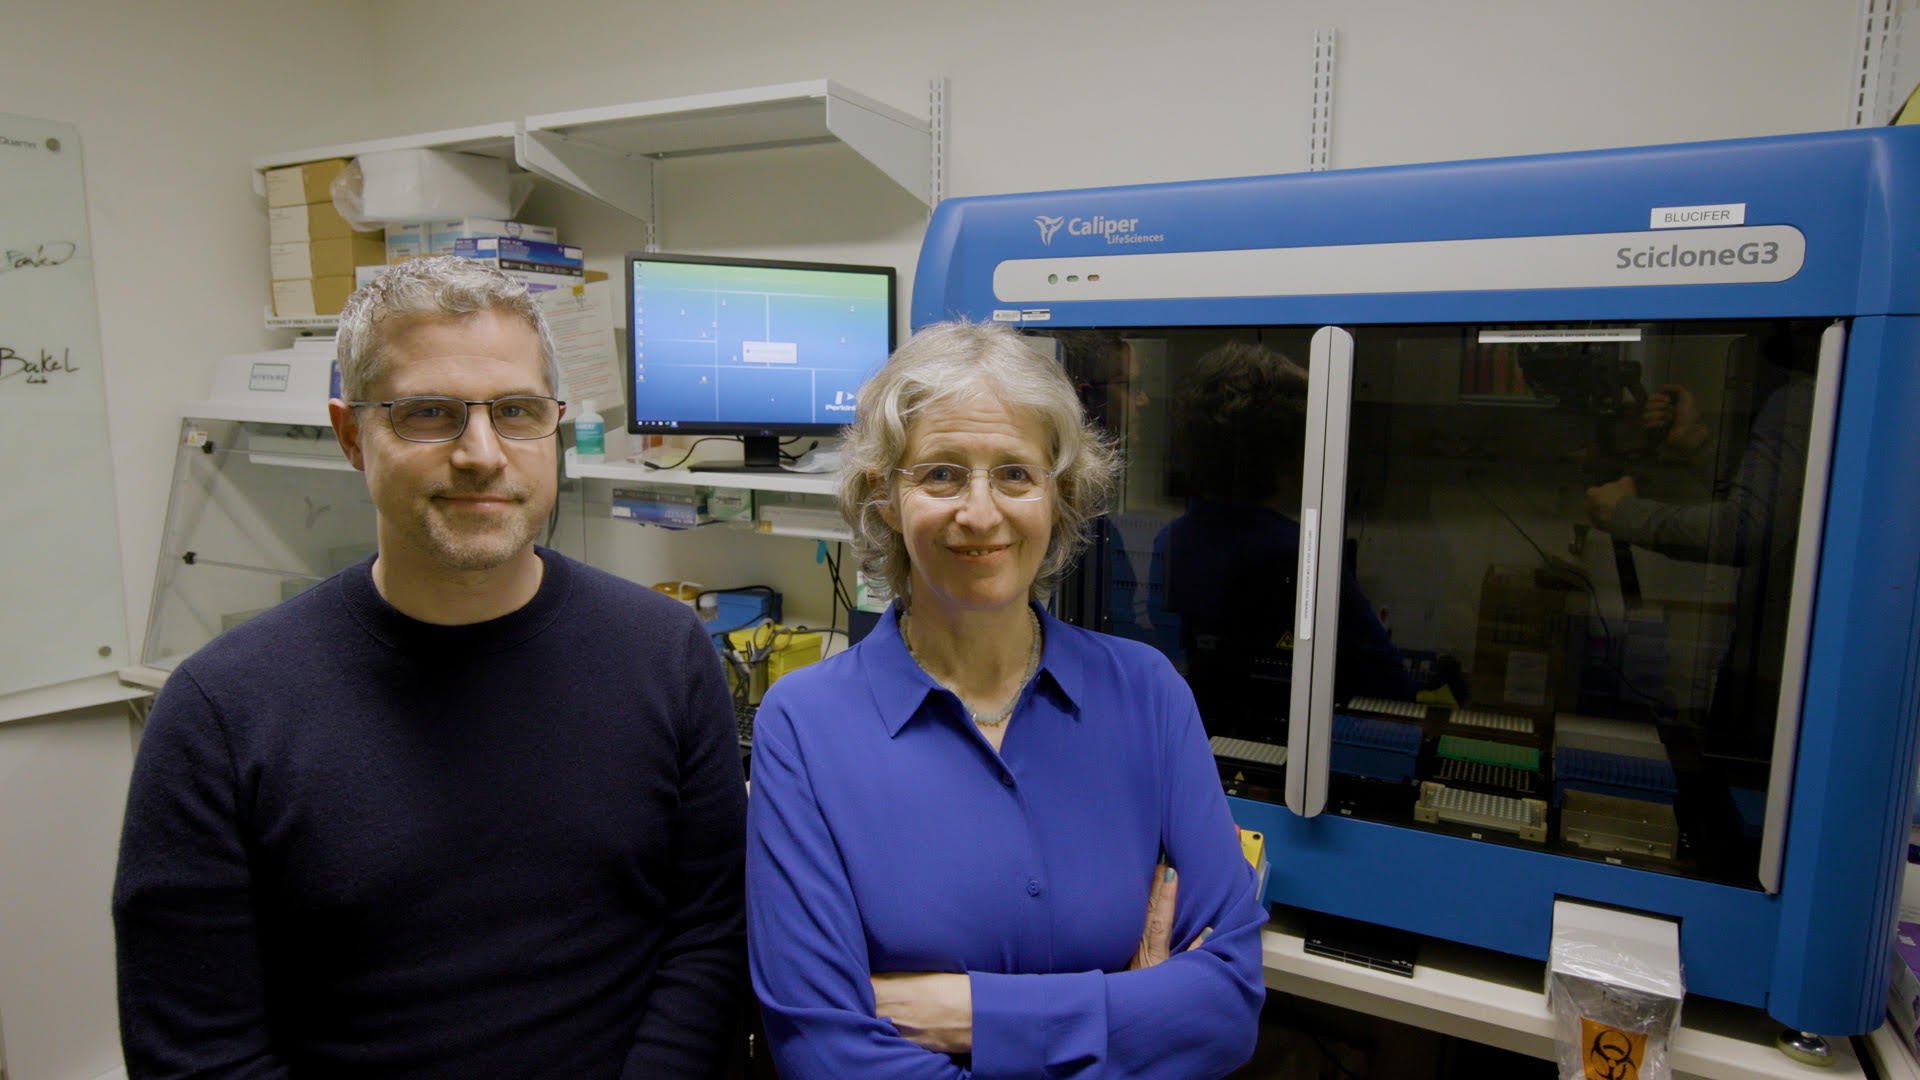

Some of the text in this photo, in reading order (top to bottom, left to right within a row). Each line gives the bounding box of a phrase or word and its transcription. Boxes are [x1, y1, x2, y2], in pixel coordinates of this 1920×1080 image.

[1664, 210, 1731, 223] BLUCIFER
[1068, 216, 1138, 239] Caliper
[1107, 234, 1164, 244] LifeSciences
[1616, 241, 1779, 269] ScicloneG3
